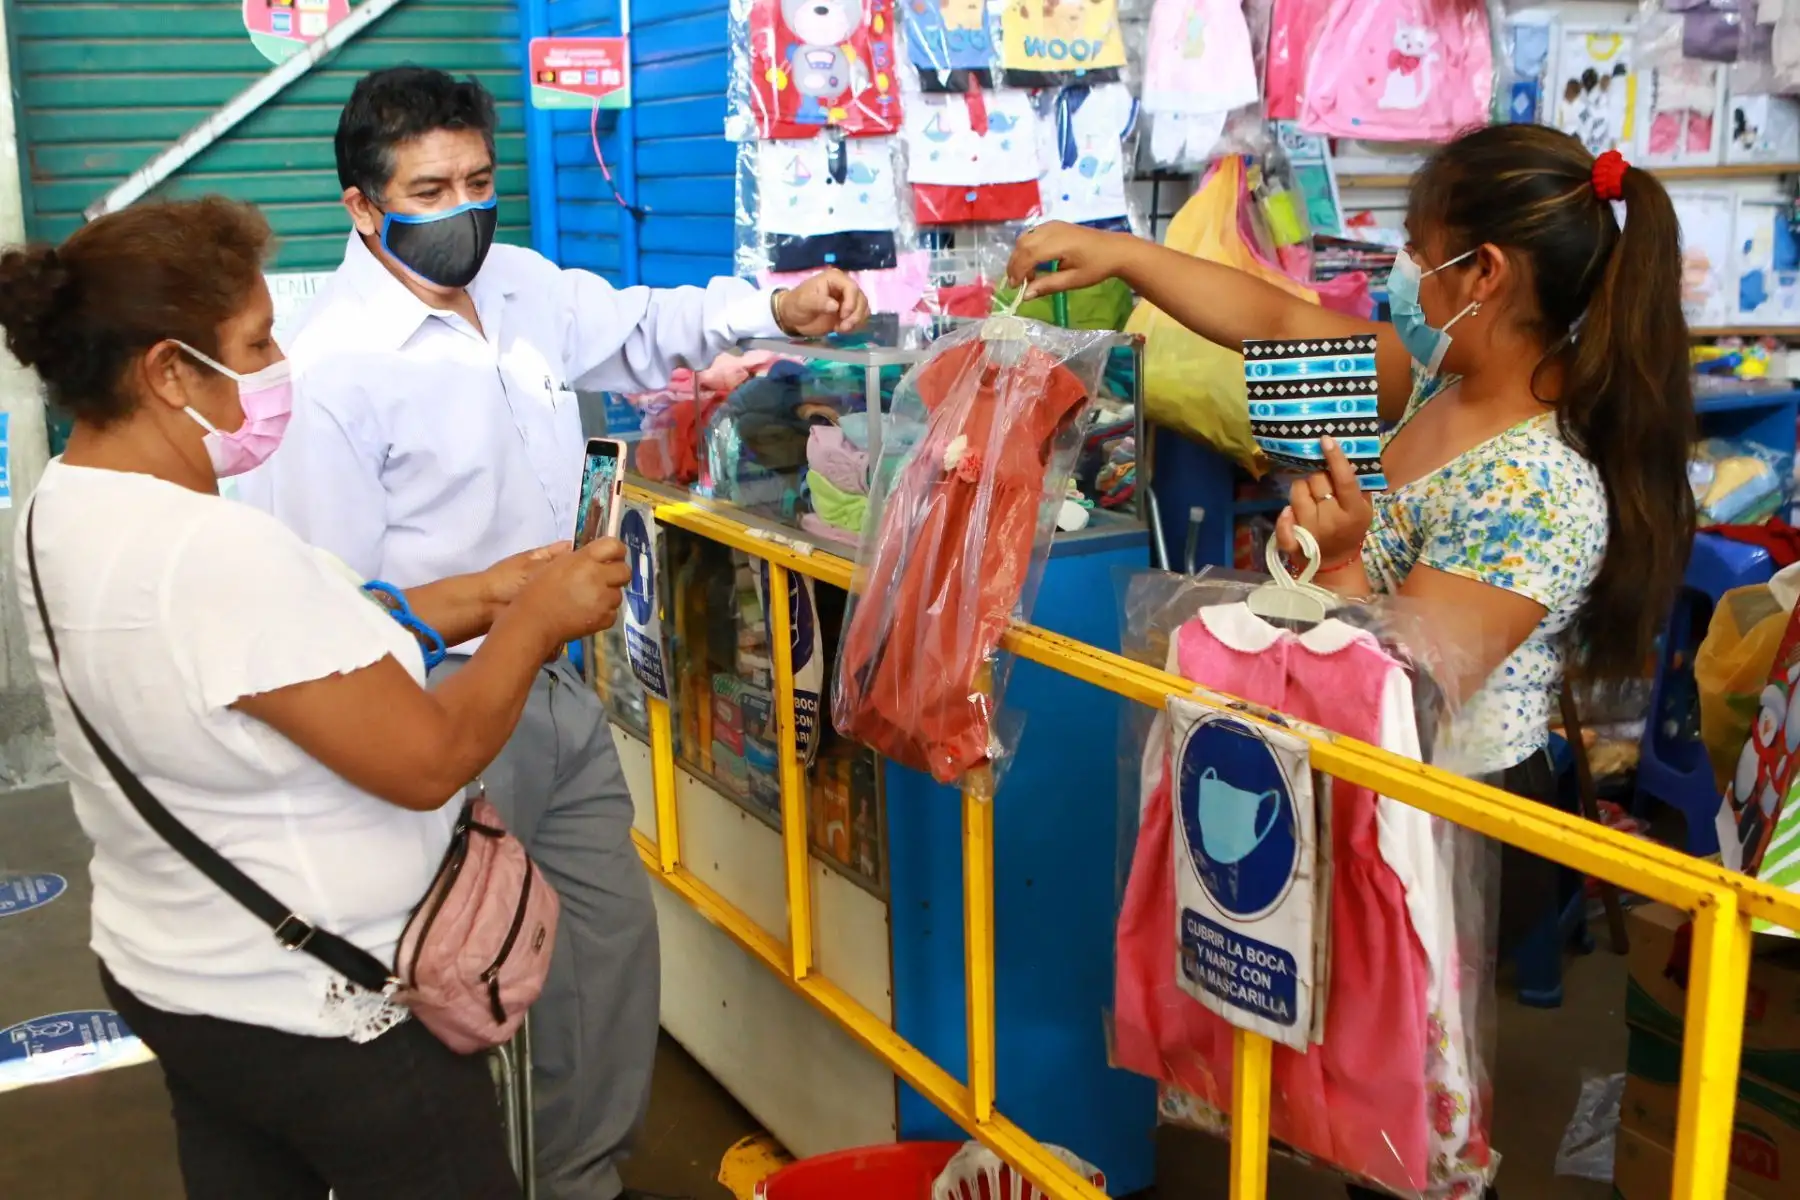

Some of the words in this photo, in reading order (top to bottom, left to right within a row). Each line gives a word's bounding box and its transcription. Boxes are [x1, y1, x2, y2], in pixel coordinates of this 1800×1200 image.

[1187, 919, 1225, 951] CUBRIR
[1227, 938, 1243, 959] LA
[1246, 945, 1287, 975] BOCA
[1197, 942, 1204, 957] Y
[1205, 948, 1238, 977] NARIZ
[1240, 966, 1272, 990] CON
[1207, 968, 1288, 1018] MASCARILLA
